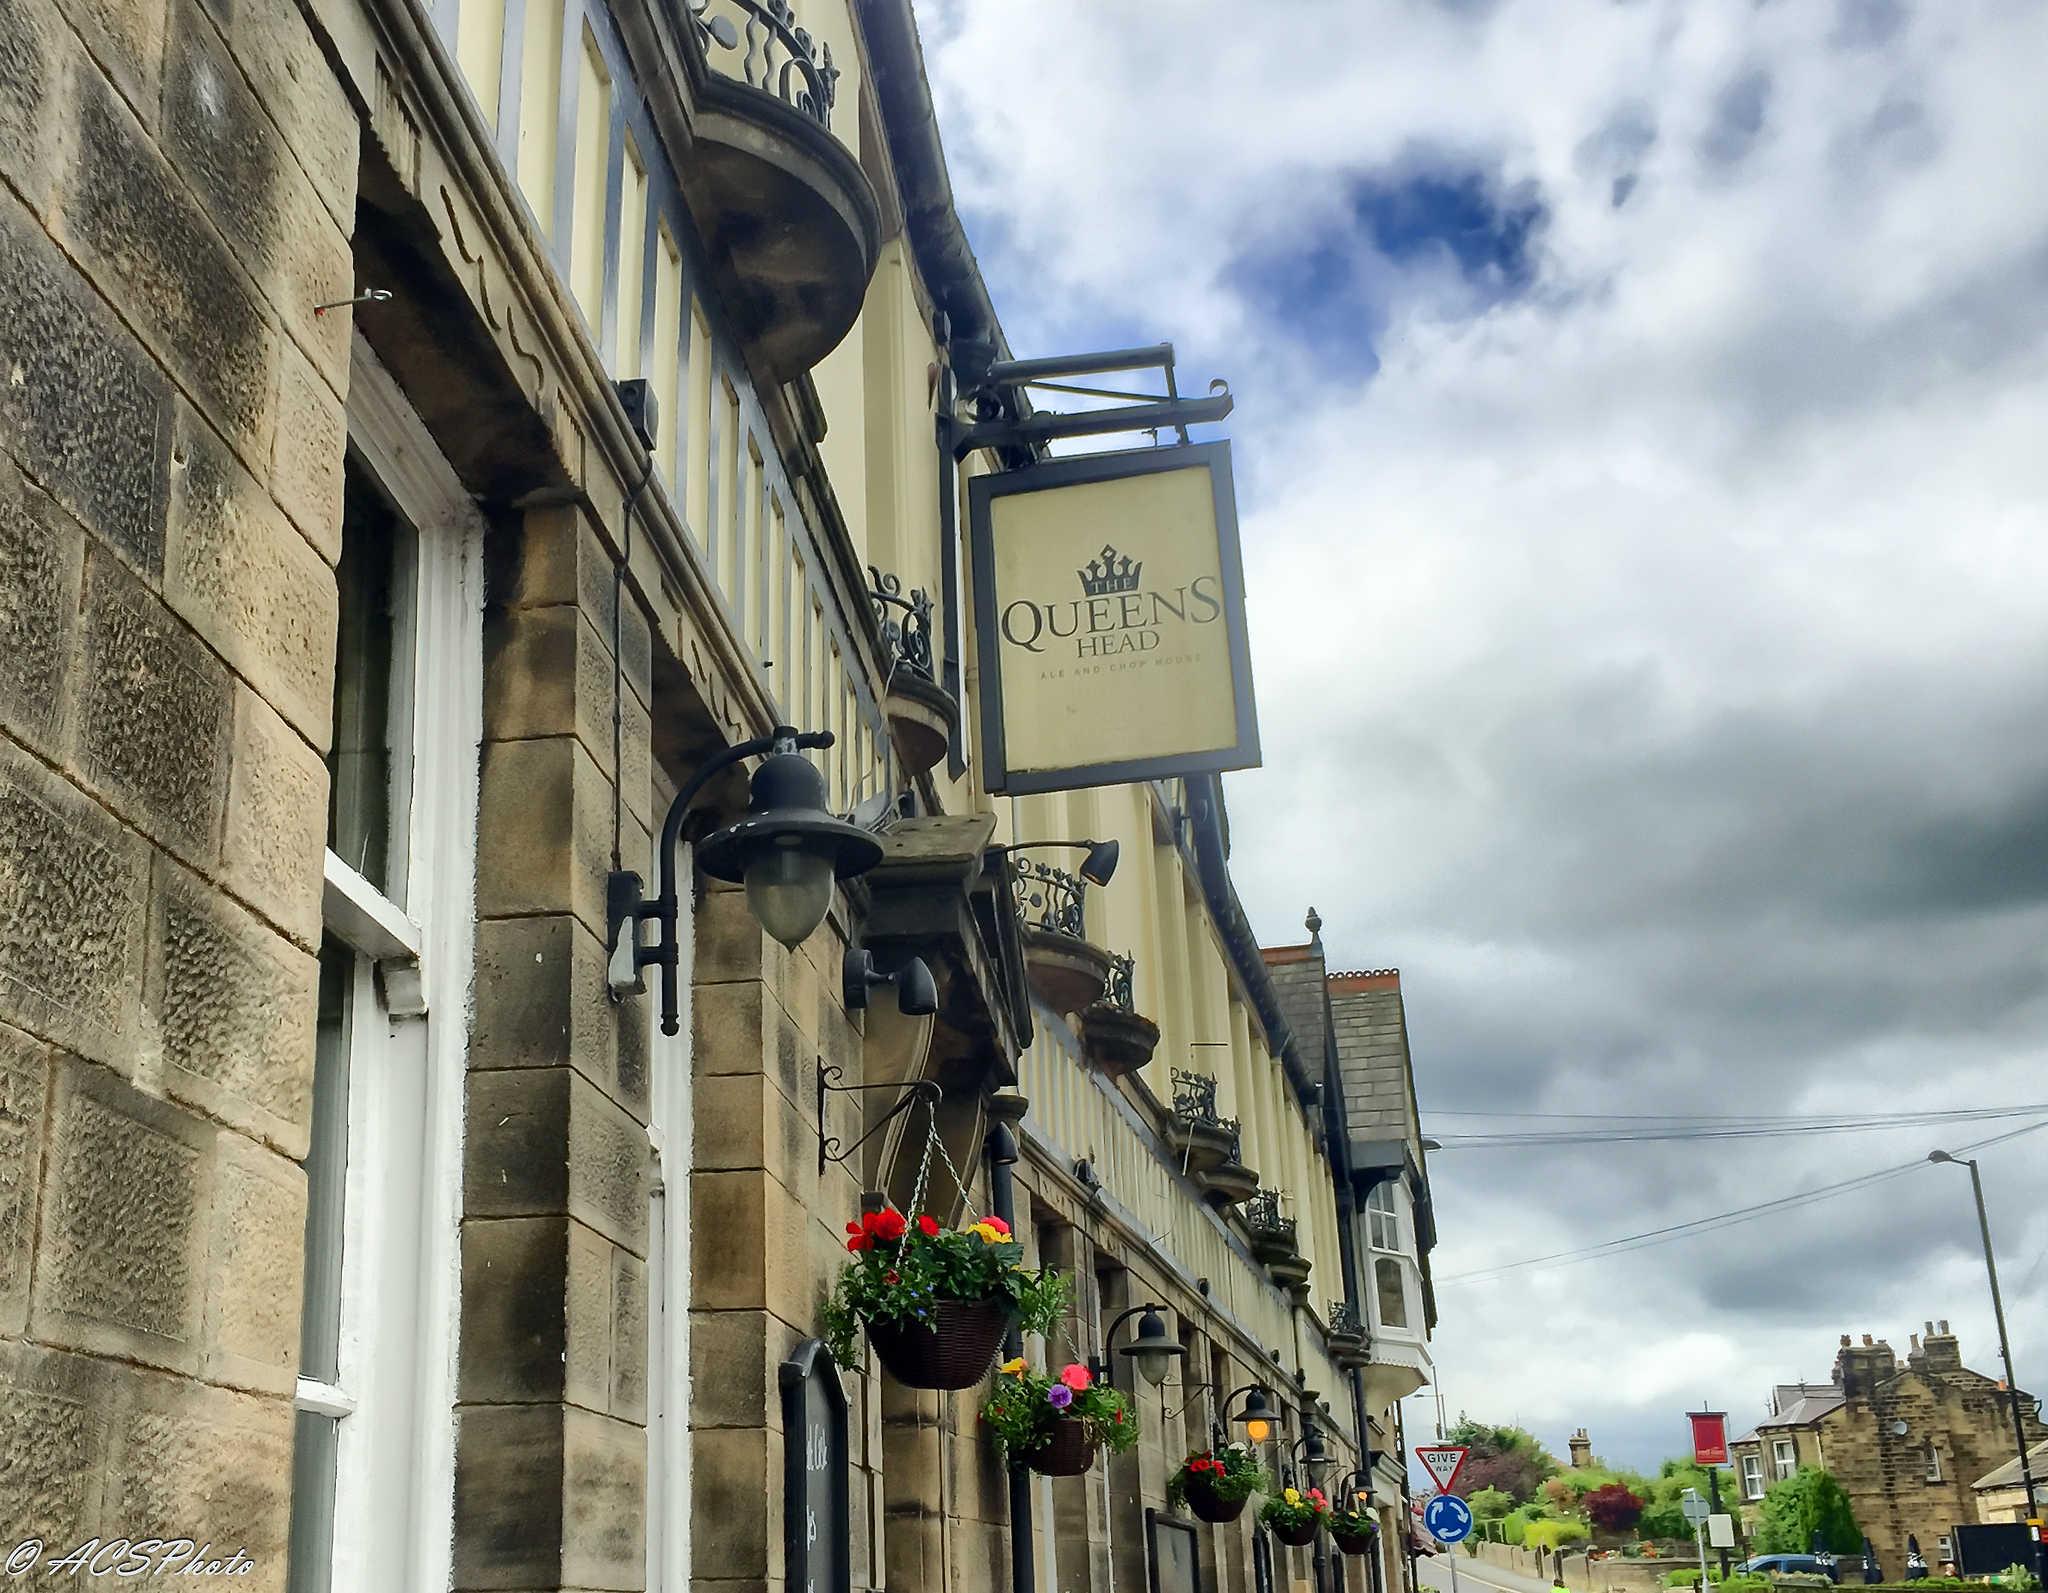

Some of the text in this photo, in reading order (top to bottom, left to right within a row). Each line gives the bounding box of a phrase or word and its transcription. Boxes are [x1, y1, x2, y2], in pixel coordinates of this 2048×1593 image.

[1091, 577, 1133, 593] THE
[1001, 576, 1221, 652] QUEENS
[1076, 630, 1160, 658] HEAD
[1040, 669, 1065, 681] ALE
[1074, 665, 1101, 677] AND
[1109, 660, 1147, 672] CHOP
[1427, 1453, 1457, 1463] GIVE
